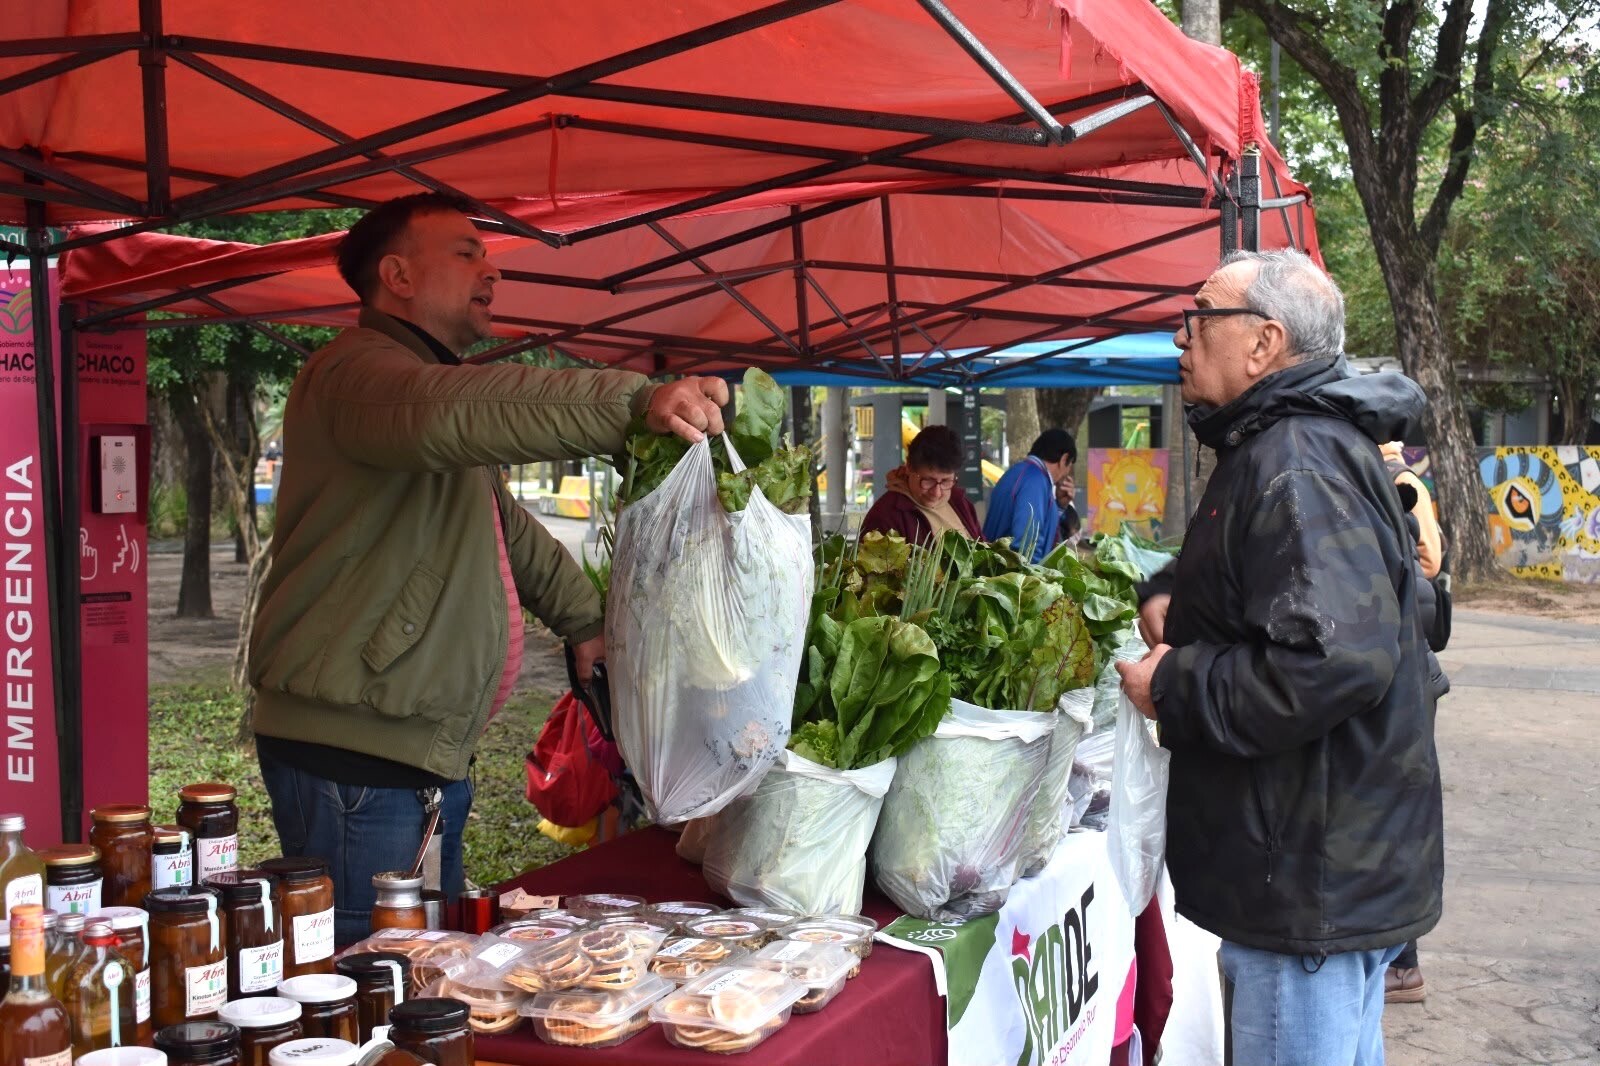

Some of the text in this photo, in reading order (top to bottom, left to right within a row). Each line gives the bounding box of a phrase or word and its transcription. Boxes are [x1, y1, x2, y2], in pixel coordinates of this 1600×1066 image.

[0, 353, 35, 371] HAC
[76, 353, 135, 374] CHACO
[5, 455, 35, 783] EMERGENCIA
[168, 857, 191, 870] Abri
[14, 886, 37, 901] Abril
[61, 888, 93, 902] Abril
[138, 974, 150, 988] bri
